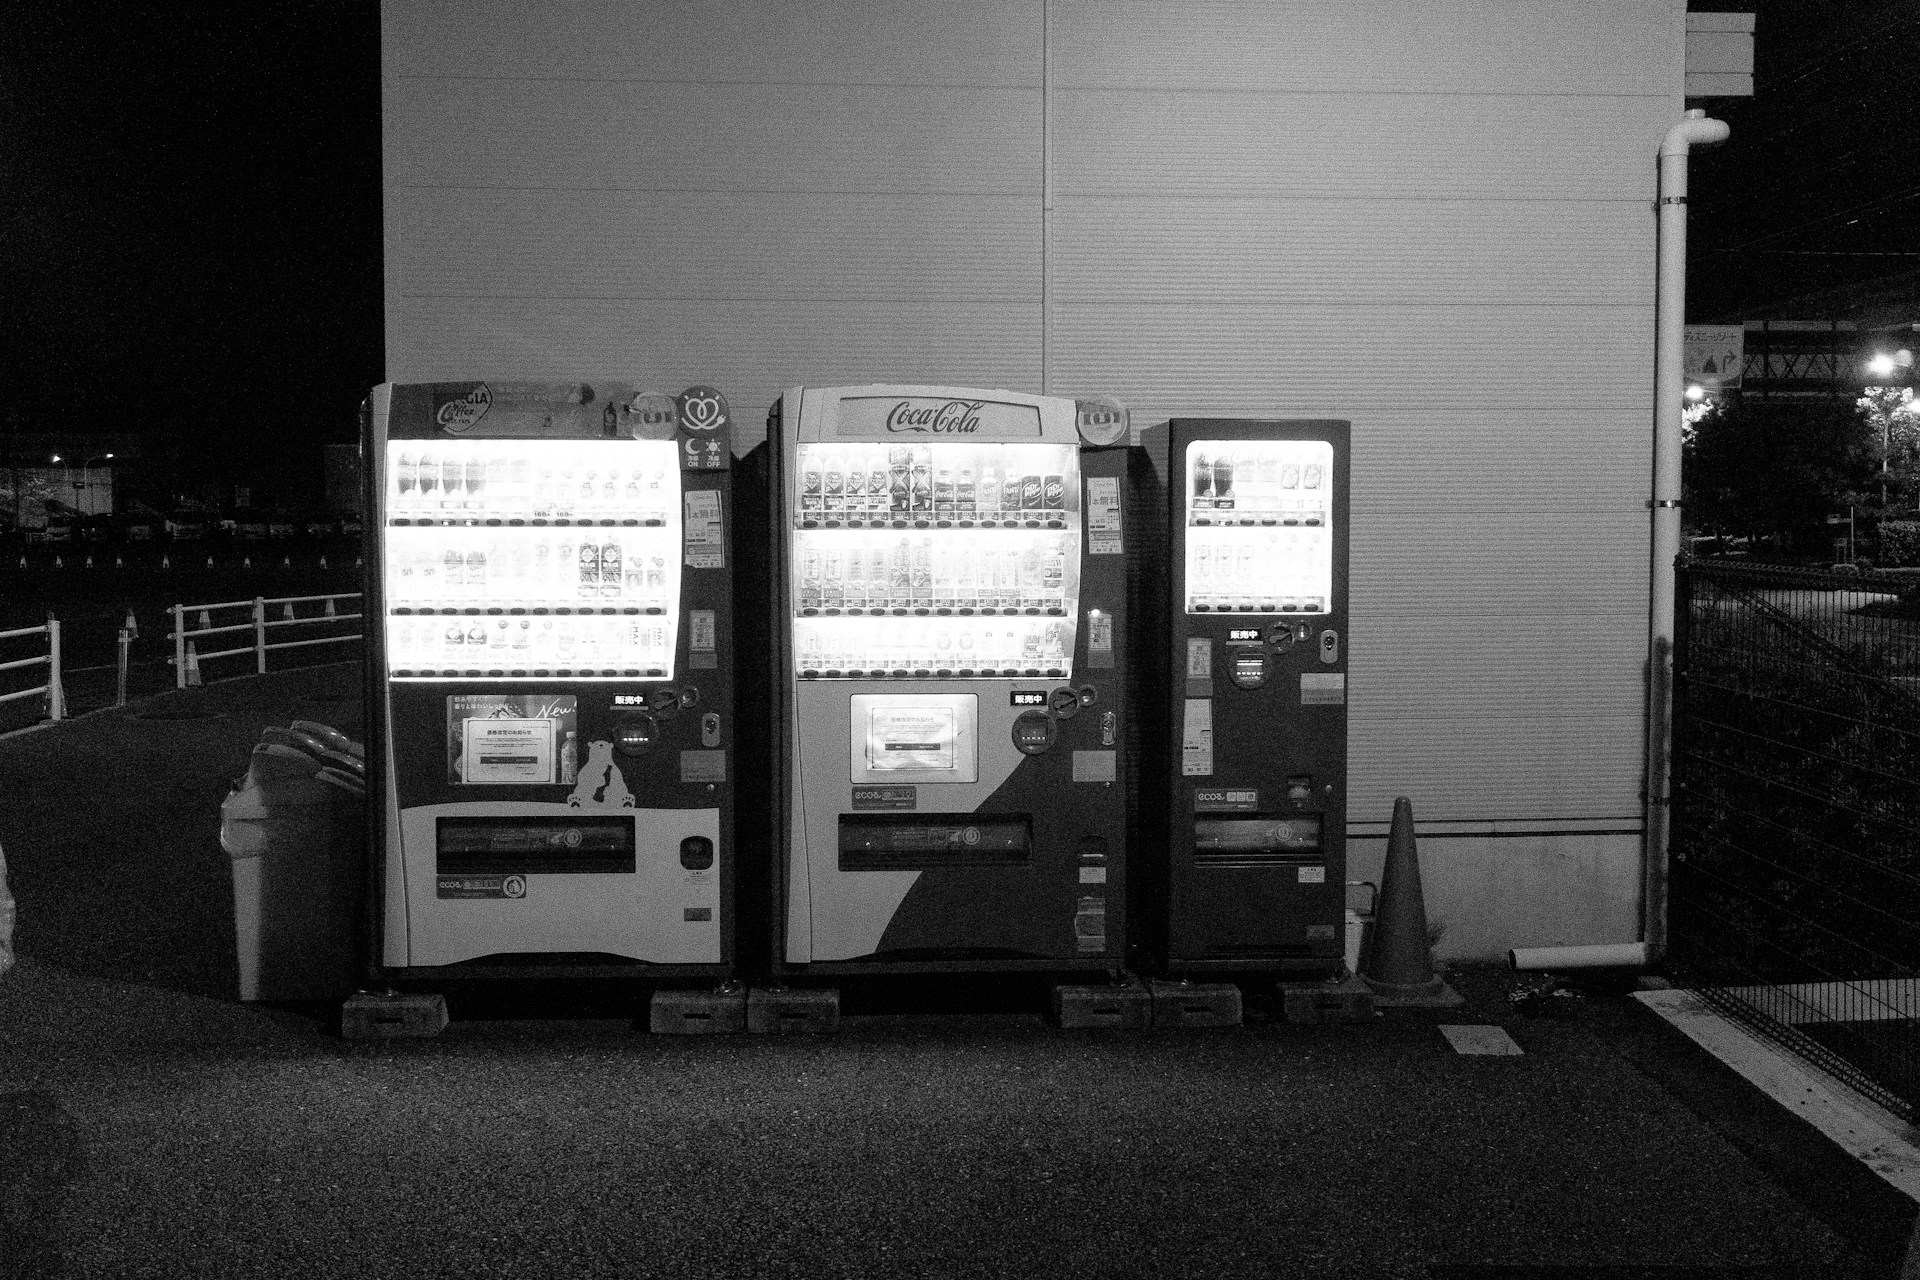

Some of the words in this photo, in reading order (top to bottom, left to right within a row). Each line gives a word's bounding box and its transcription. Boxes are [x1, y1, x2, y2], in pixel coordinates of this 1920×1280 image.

[1230, 630, 1258, 639] 販売中
[614, 695, 643, 704] 販売中
[1015, 695, 1043, 704] 販売中
